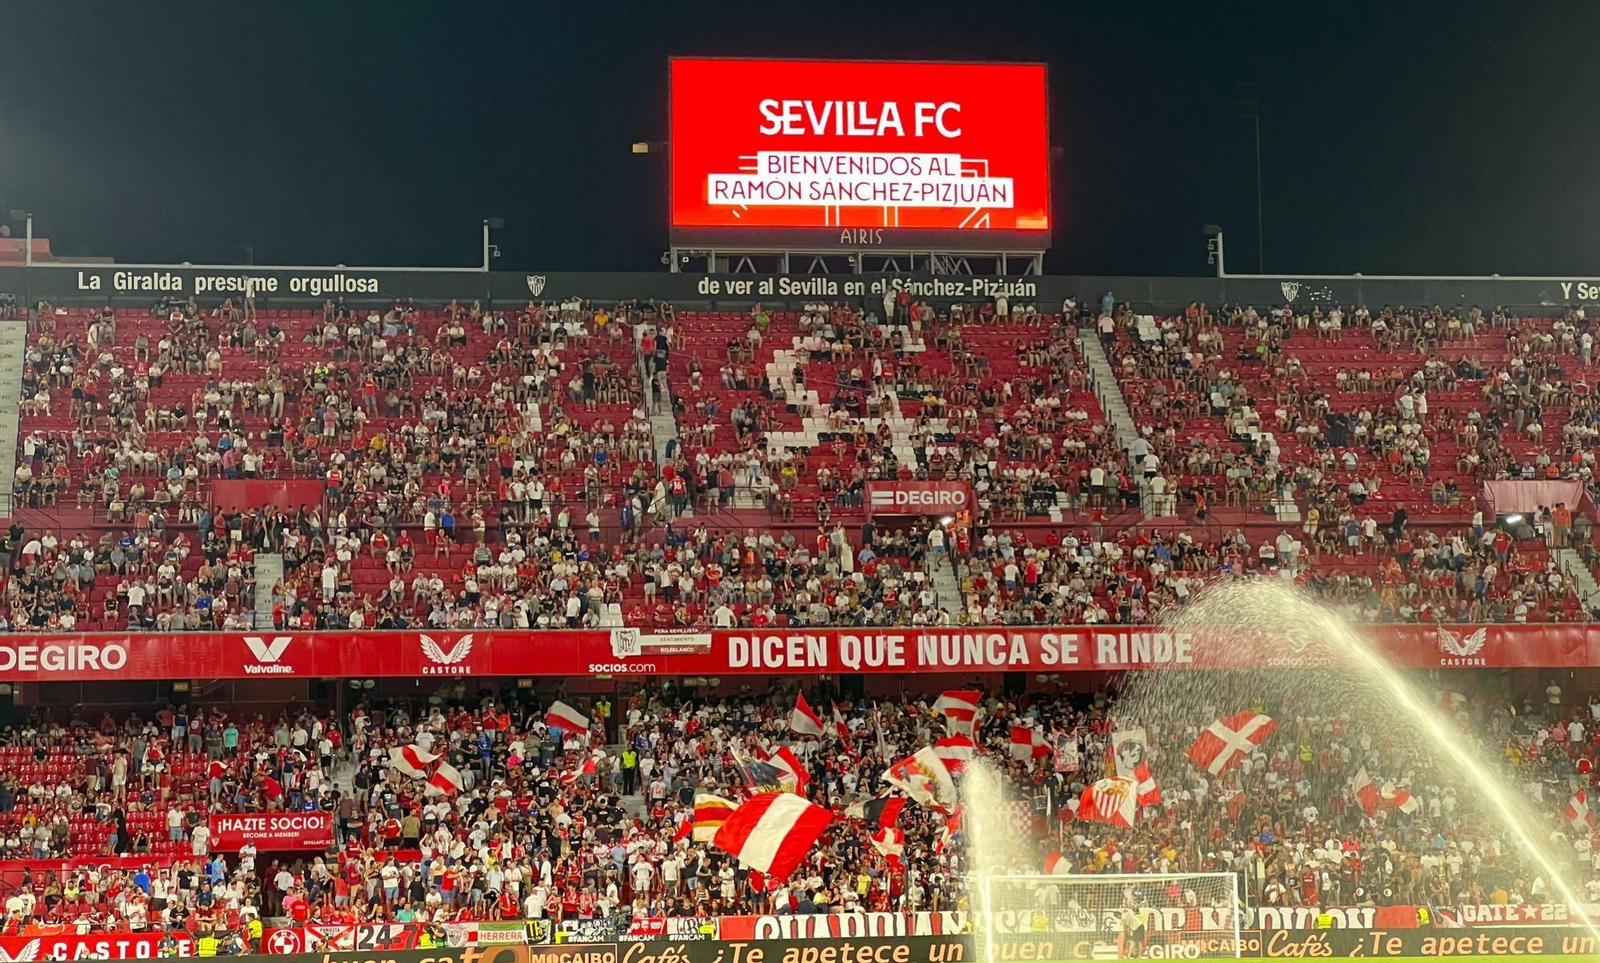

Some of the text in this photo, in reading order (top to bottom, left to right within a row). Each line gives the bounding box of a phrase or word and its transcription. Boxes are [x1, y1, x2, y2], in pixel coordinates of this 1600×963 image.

[759, 98, 961, 138] SEVILLA FC
[767, 154, 956, 176] BIENVENIDOS AL
[715, 177, 1007, 205] RAMÓN SÁNCHEZ-PIZJUÁN
[840, 228, 883, 245] AIRIS
[78, 271, 379, 297] La Giralda presume orgullosa
[698, 277, 720, 295] de
[725, 280, 754, 295] ver
[759, 277, 774, 295] al
[779, 277, 838, 296] Sevilla
[843, 281, 865, 295] en
[871, 278, 886, 295] el
[1560, 282, 1600, 300] Y Se
[895, 490, 966, 506] DEGIRO
[0, 645, 127, 671] DEGIRO
[728, 633, 1193, 670] DICEN QUE NUNCA SE RINDE
[422, 666, 471, 674] CASTORE
[1441, 658, 1487, 666] CASTORE
[217, 816, 325, 834] ¡HAZTE SOCIO!
[1462, 903, 1520, 922] GATE
[1541, 903, 1568, 921] 22
[358, 925, 419, 951] 24-7
[480, 930, 523, 941] HERRERA
[568, 935, 605, 943] #FANCAM
[618, 934, 655, 942] #FANCAM
[1267, 929, 1333, 958] Cafés
[1348, 931, 1403, 958] ¿Te
[1420, 934, 1543, 957] apetece
[1562, 936, 1595, 955] un
[782, 942, 910, 963] apetece
[928, 942, 964, 962] un
